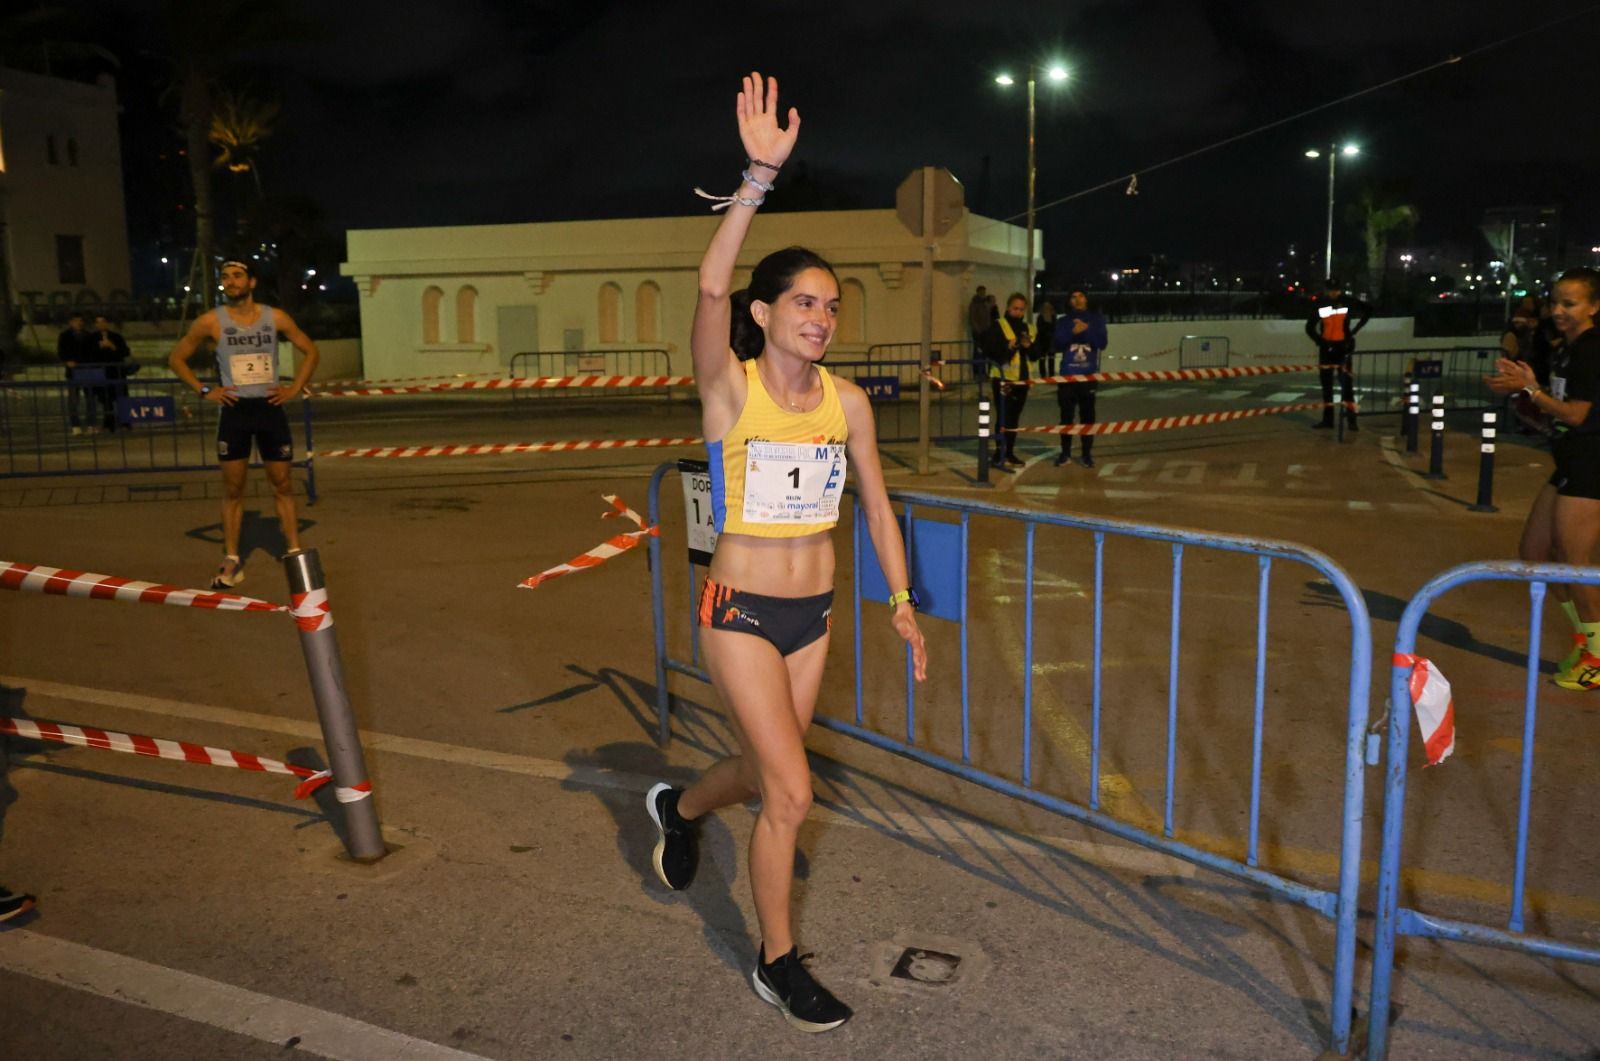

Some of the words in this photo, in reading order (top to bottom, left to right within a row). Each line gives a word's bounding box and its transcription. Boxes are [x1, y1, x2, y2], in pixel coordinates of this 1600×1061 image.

[227, 332, 272, 347] nerja
[246, 363, 255, 372] 2
[129, 406, 165, 418] APM
[815, 447, 828, 460] M
[787, 467, 800, 489] 1
[692, 498, 700, 525] 1
[787, 501, 818, 512] mayoral
